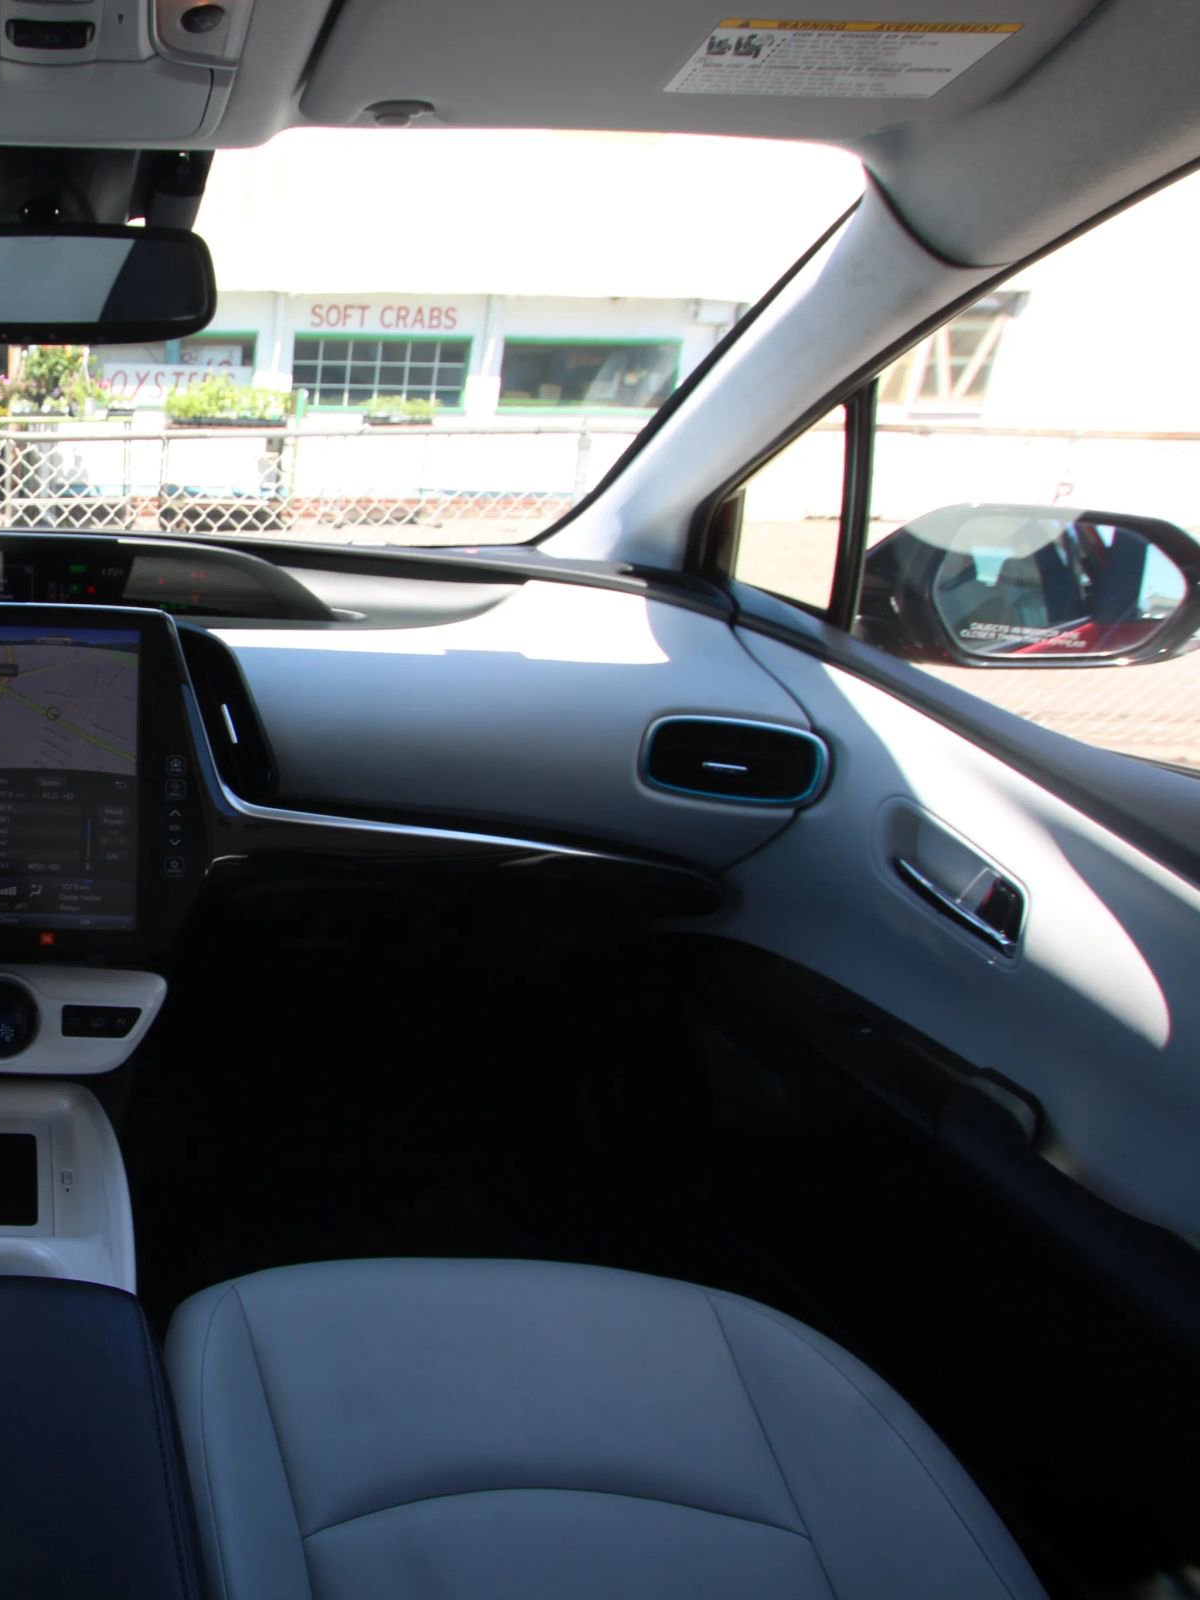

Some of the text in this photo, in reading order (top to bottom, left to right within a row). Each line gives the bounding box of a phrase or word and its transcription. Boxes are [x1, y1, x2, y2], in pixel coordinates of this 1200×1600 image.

[777, 21, 848, 31] WARNING
[873, 22, 1003, 33] AVERTISSEMENT
[310, 304, 458, 329] SOFT CRABS
